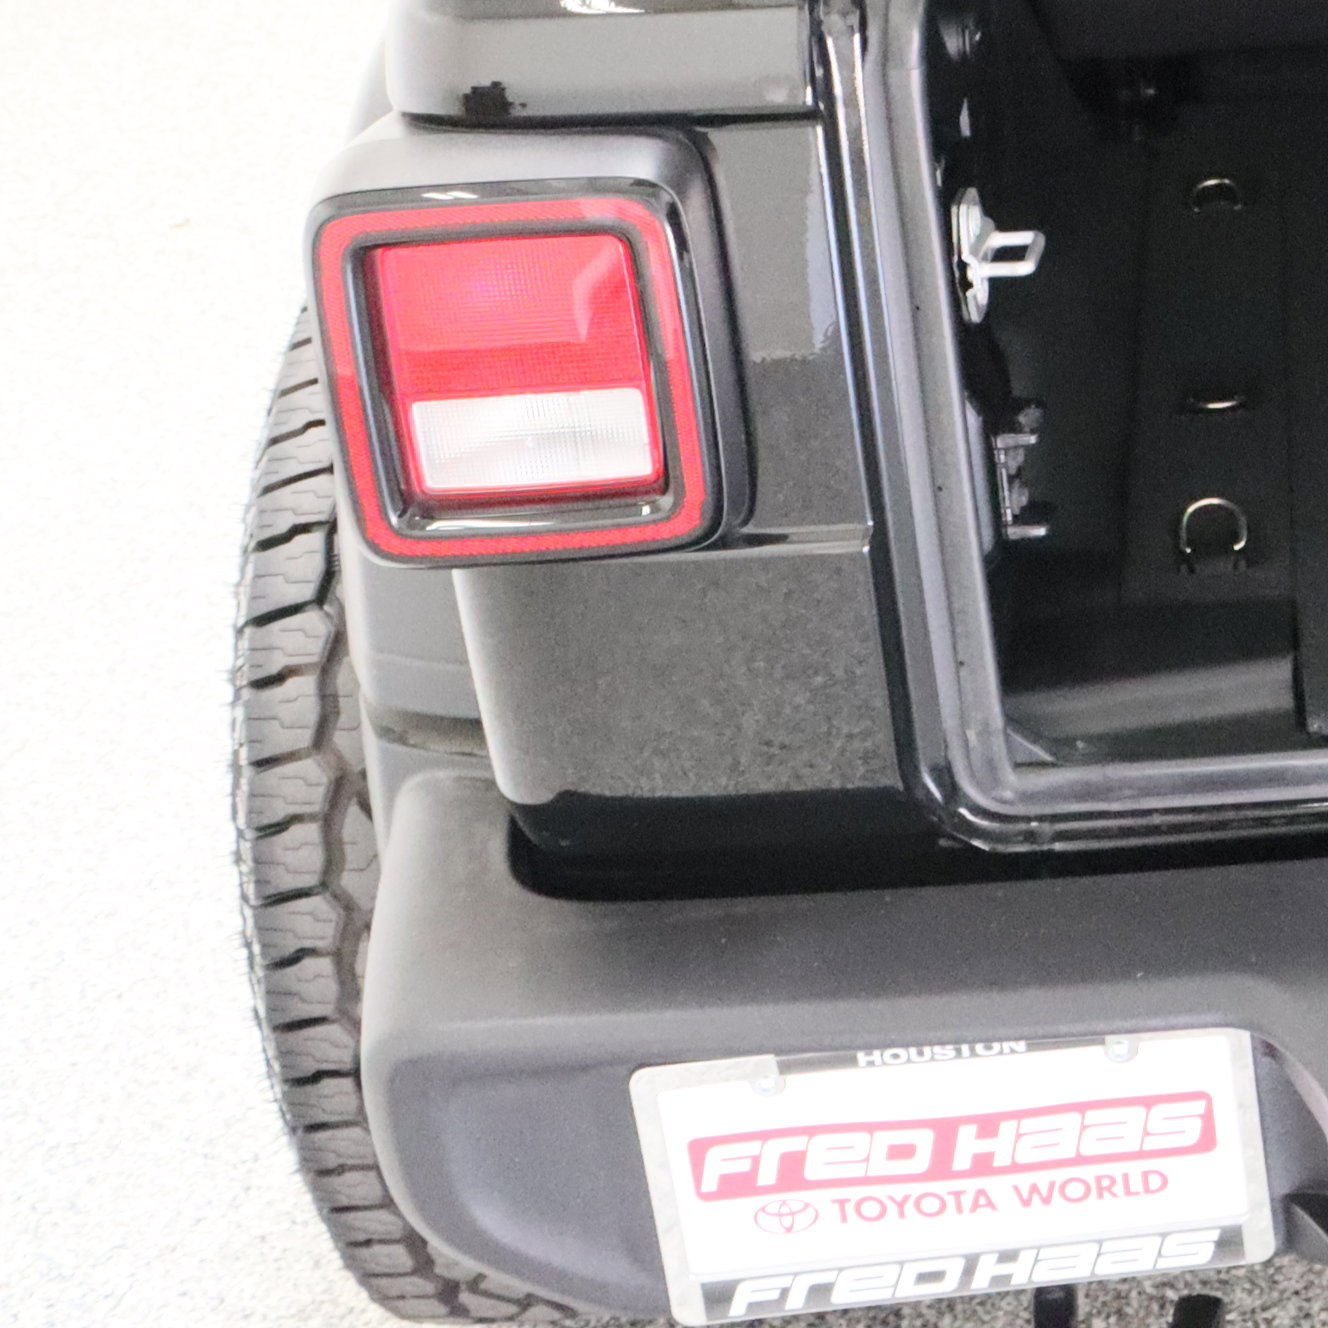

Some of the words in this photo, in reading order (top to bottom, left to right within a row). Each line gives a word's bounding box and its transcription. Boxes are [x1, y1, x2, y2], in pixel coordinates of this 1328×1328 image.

[856, 1040, 1027, 1067] HOUSTON
[831, 1189, 998, 1224] TOYOTA
[1011, 1170, 1169, 1209] WORLD
